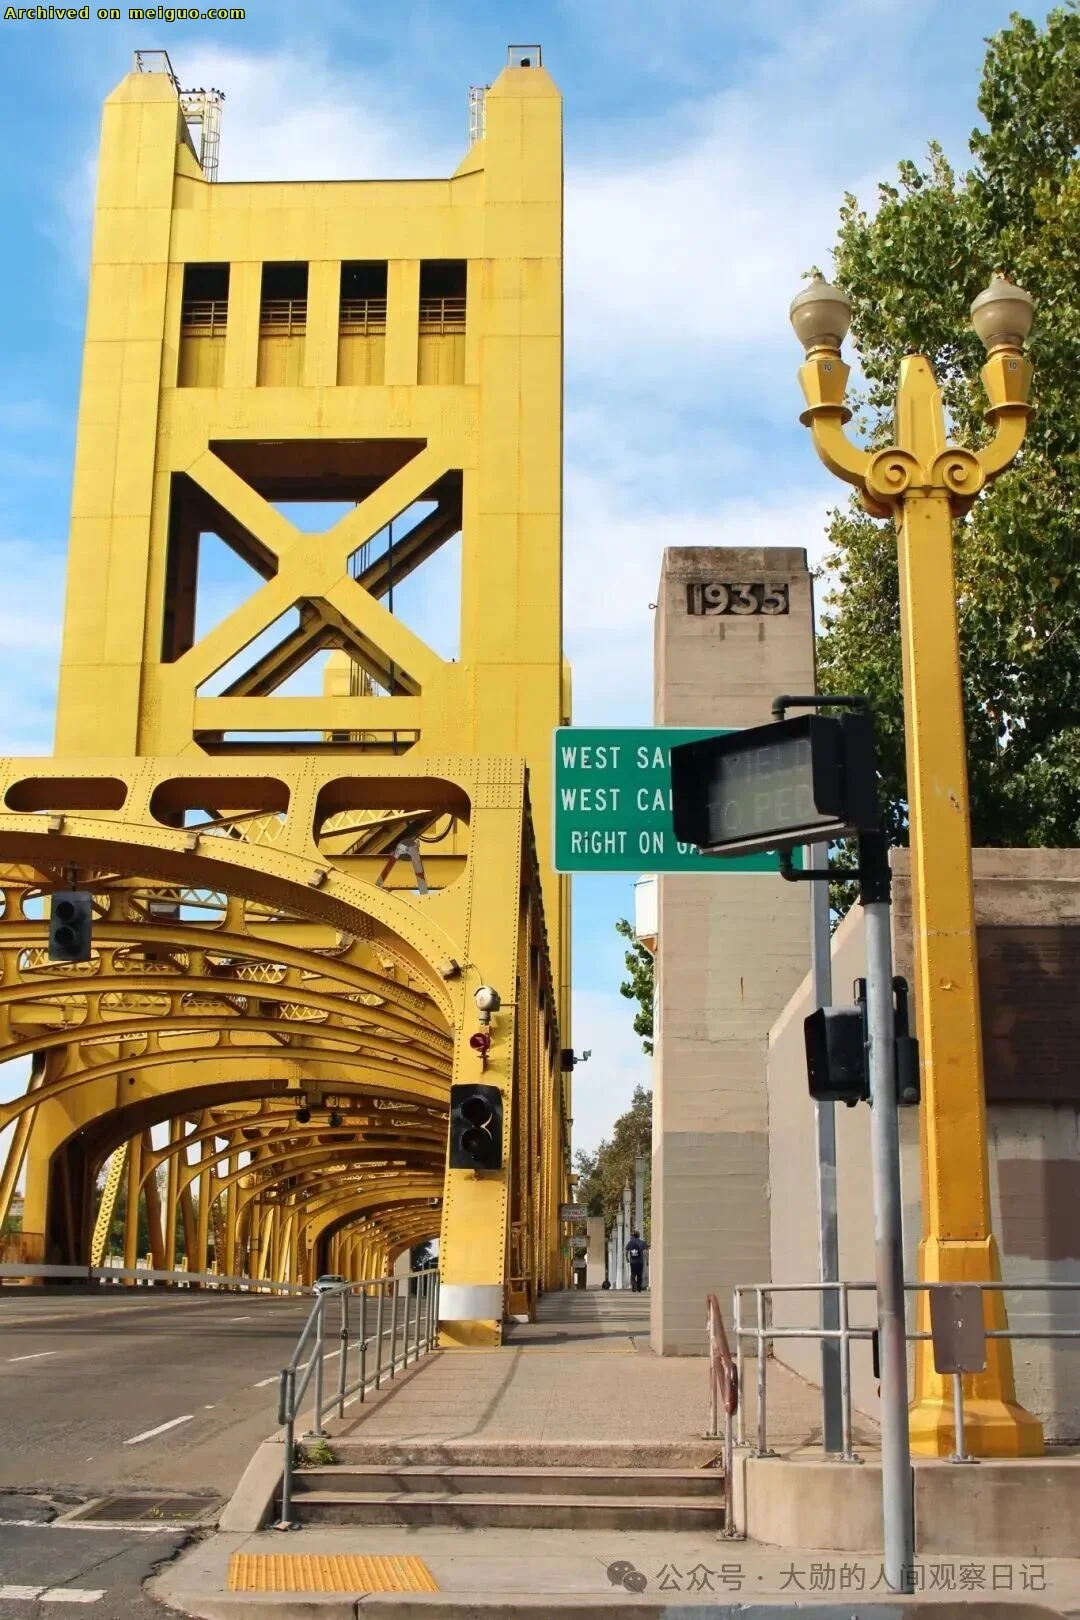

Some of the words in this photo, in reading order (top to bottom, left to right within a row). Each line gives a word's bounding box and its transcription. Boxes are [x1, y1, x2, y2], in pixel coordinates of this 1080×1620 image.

[693, 583, 787, 615] 1935
[561, 746, 621, 769] WEST
[636, 746, 671, 769] SA
[560, 788, 621, 811] WEST
[639, 831, 664, 854] ON
